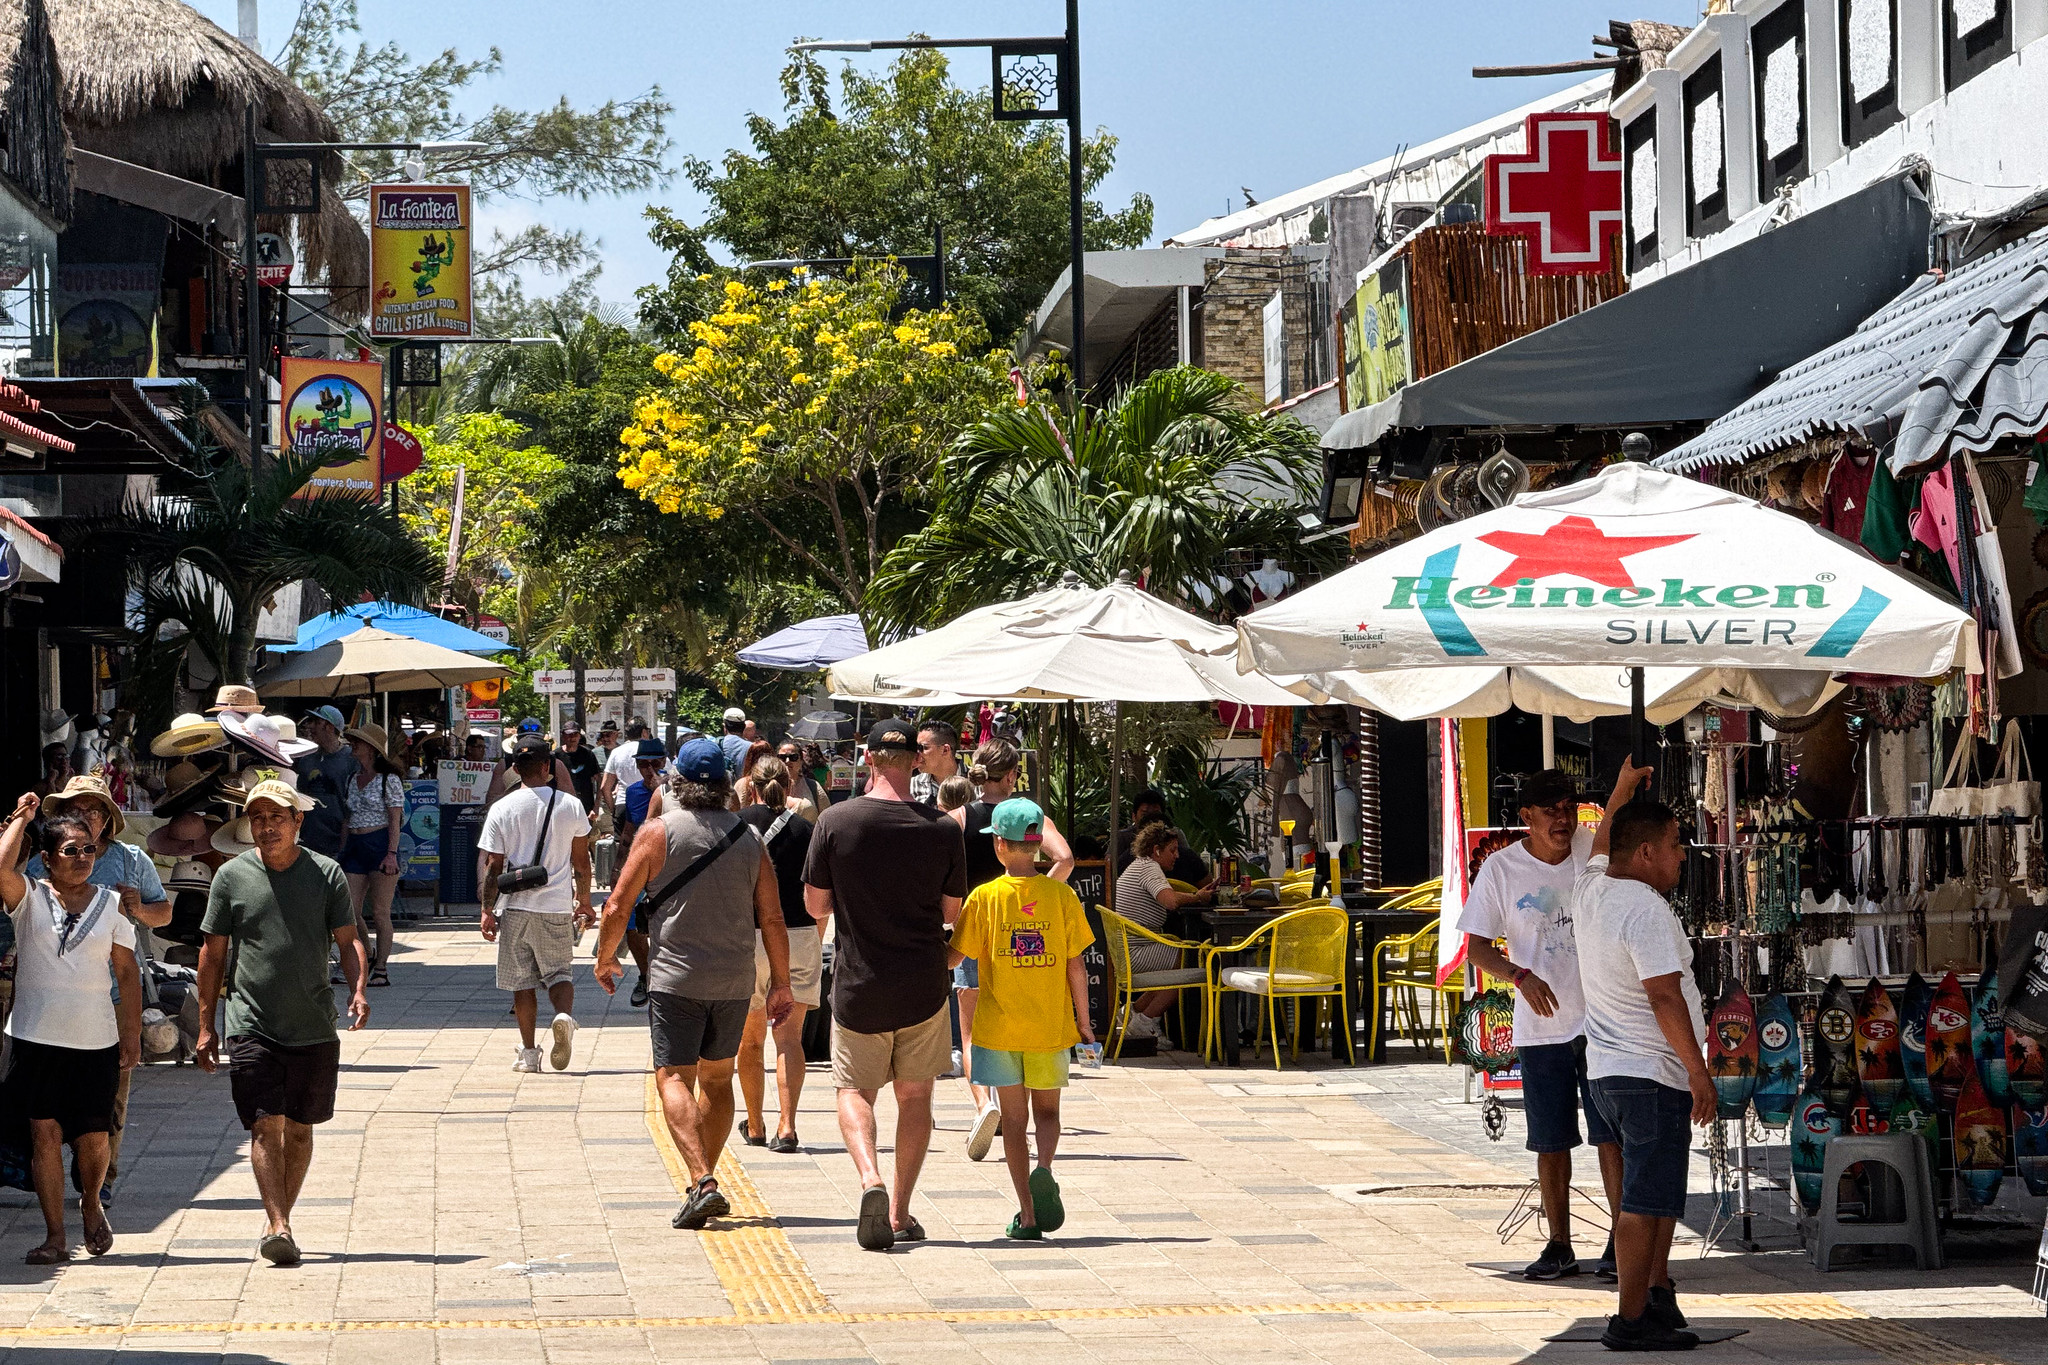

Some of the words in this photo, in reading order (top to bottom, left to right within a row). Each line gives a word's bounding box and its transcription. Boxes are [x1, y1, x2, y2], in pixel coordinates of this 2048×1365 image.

[381, 200, 398, 219] La
[400, 197, 456, 219] frontera
[411, 299, 437, 311] MEXICAN
[375, 315, 404, 333] GRILL
[405, 311, 436, 332] STEAK
[442, 317, 468, 333] LOBSTER
[384, 426, 415, 450] ORE
[346, 477, 374, 490] Quinta
[1382, 576, 1831, 610] Heineken
[1342, 632, 1384, 642] Heineken
[1605, 619, 1797, 646] SILVER
[457, 771, 477, 785] Ferry
[451, 786, 472, 803] 300
[1012, 953, 1056, 968] LOUD
[1719, 1013, 1749, 1022] FLORIDA
